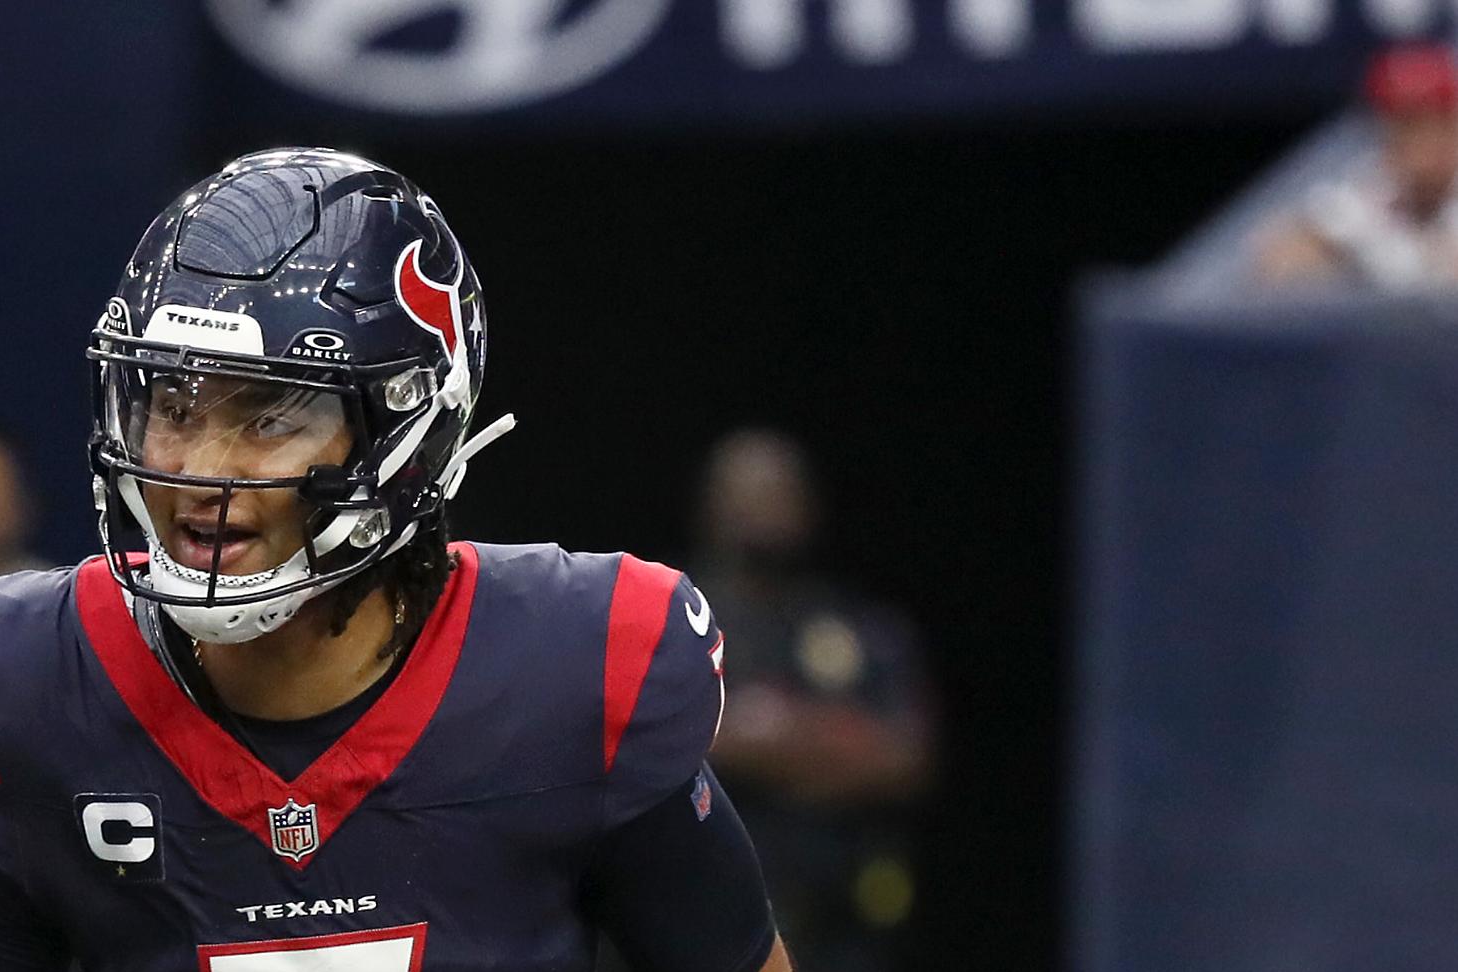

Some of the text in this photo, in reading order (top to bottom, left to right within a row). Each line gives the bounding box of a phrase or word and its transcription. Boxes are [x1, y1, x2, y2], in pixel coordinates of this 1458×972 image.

[166, 312, 240, 331] TEXANS
[292, 347, 351, 361] OAKLEY
[82, 801, 155, 863] C
[278, 827, 312, 851] NFL
[235, 895, 377, 922] TEXANS
